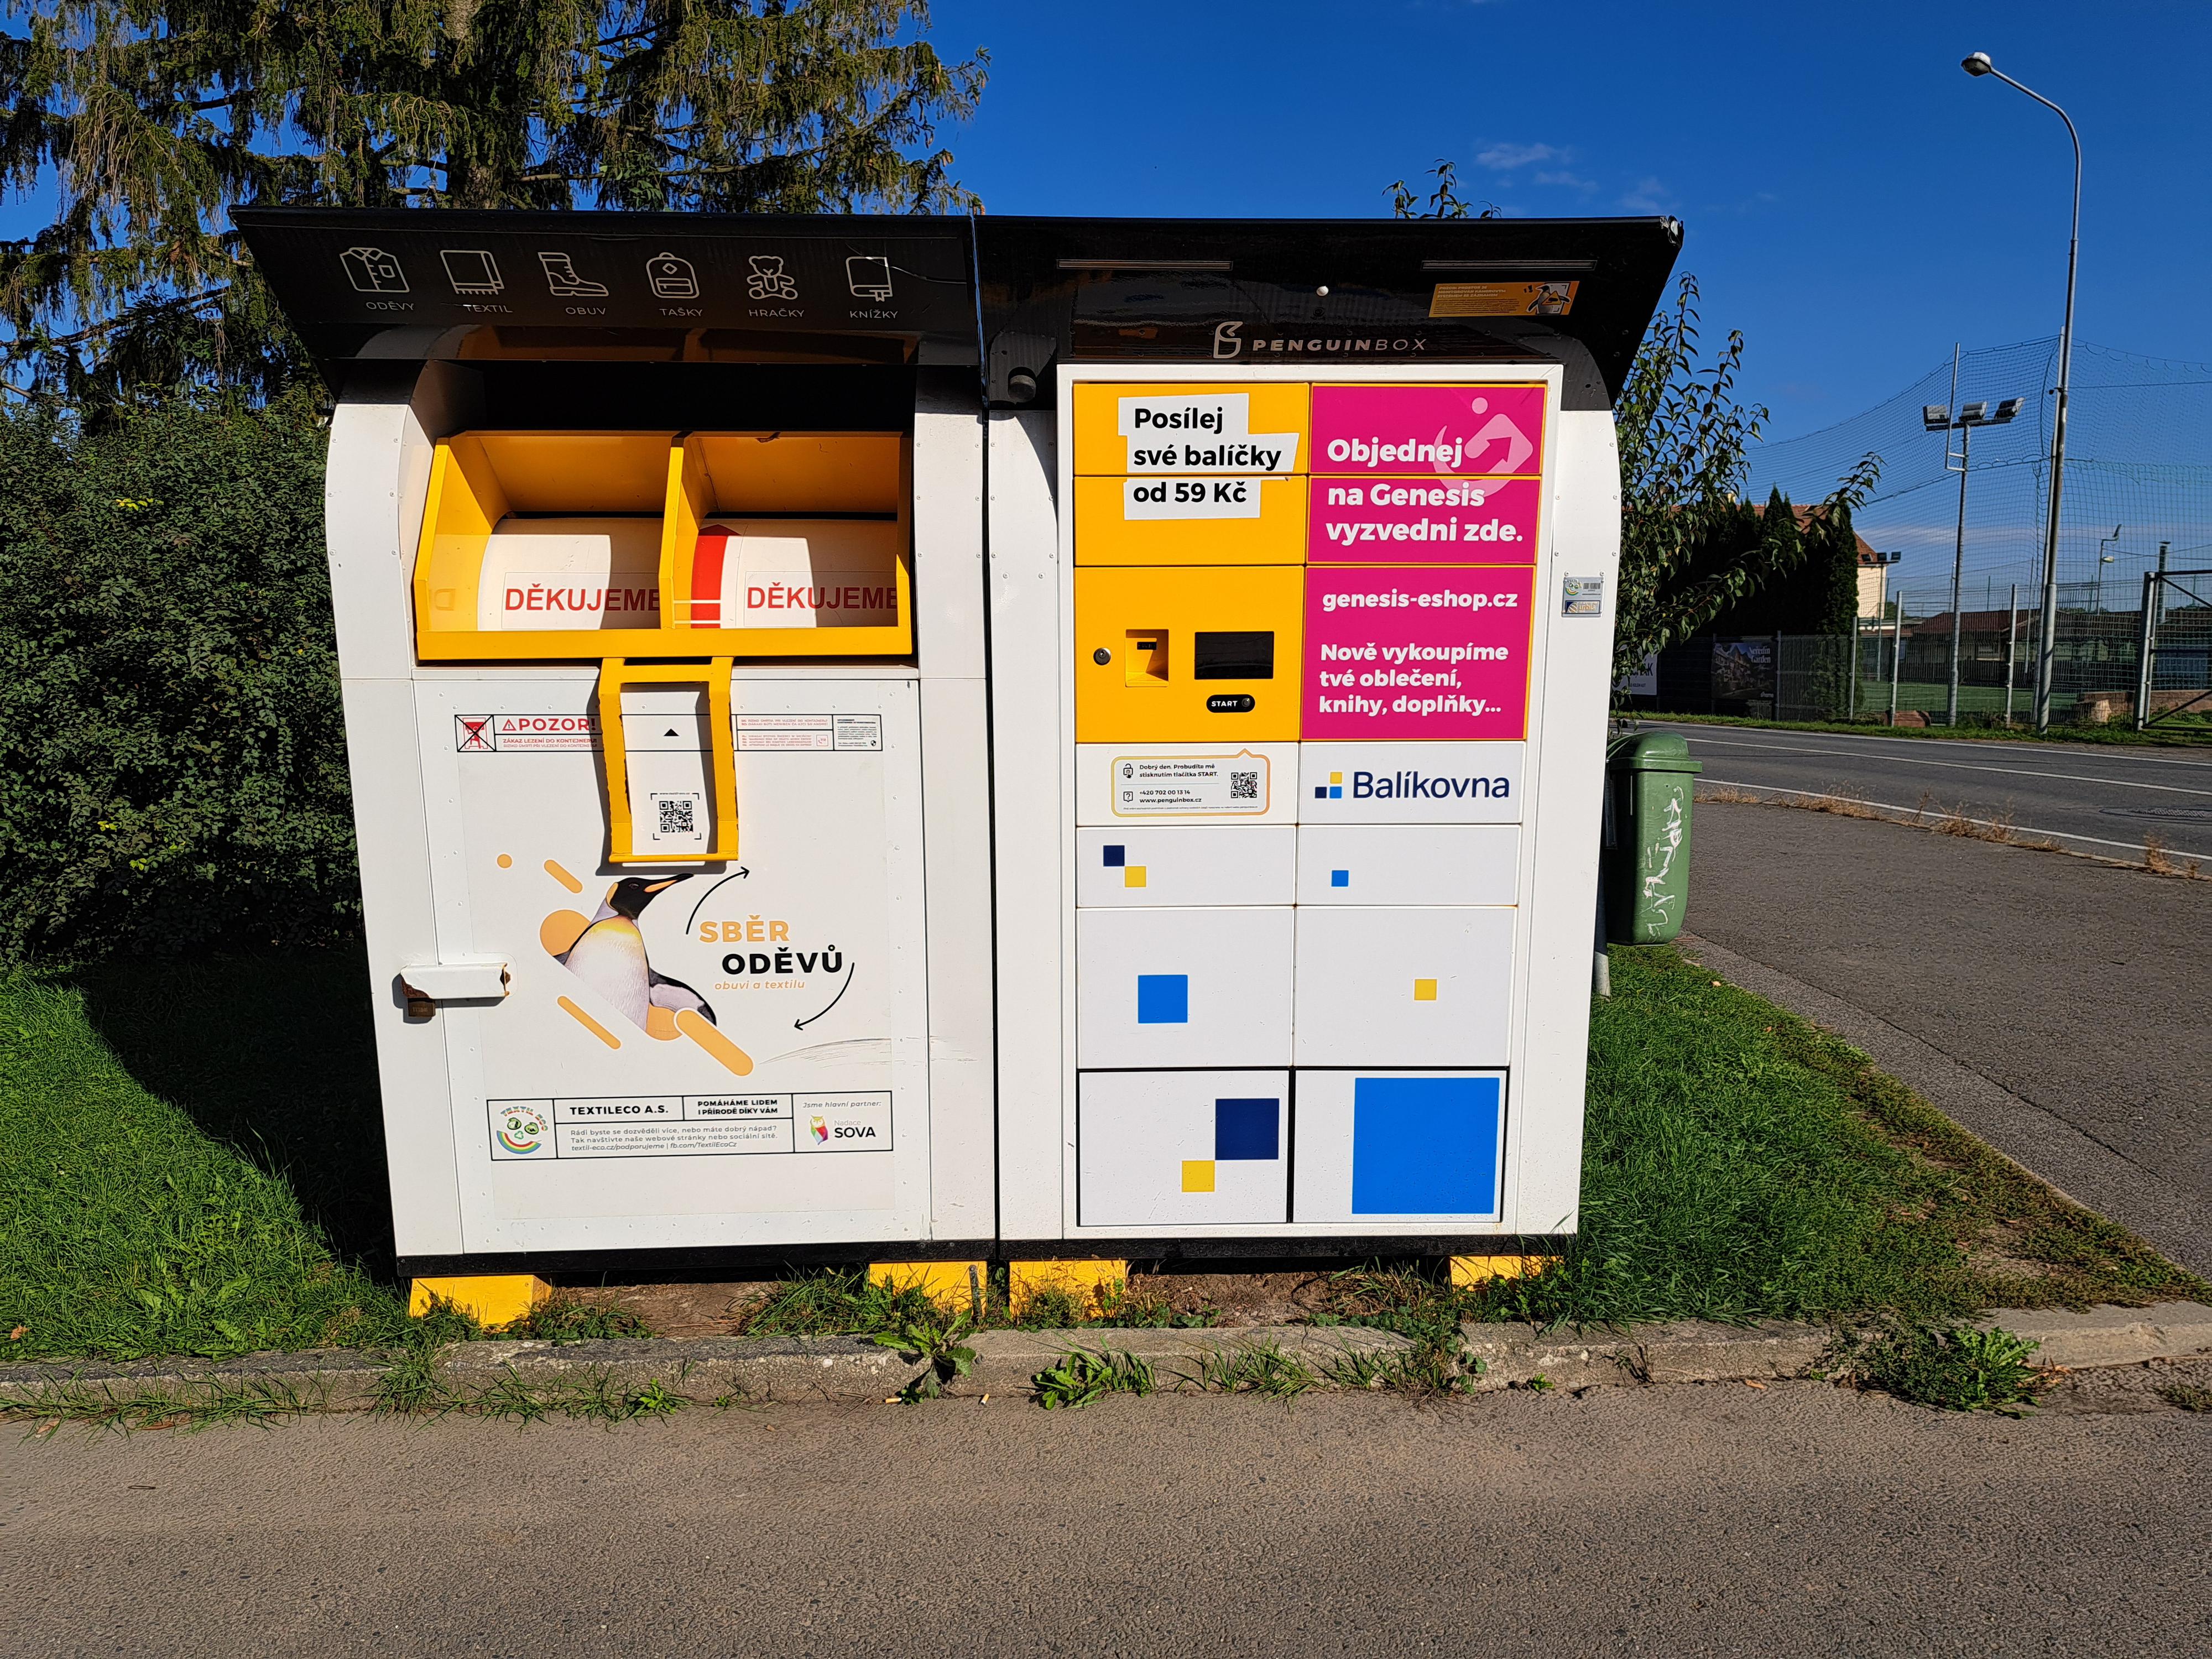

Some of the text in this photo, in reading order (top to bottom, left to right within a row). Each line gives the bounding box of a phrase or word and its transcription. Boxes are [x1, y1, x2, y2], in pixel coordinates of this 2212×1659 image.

[366, 300, 414, 311] ODĚVY
[464, 304, 513, 313] TEXTIL
[565, 306, 606, 315] OBUV
[659, 307, 703, 317] TAŠKY
[749, 307, 805, 318] HRAČKY
[849, 309, 898, 319] KNÍŽKY
[1253, 338, 1427, 352] PENGUINBOX
[1135, 406, 1223, 435] Posílej
[1134, 444, 1282, 471] své balíčky
[1327, 436, 1463, 468] Objednej
[1133, 481, 1248, 503] od 59 Kč
[1328, 482, 1485, 506] na Genesis
[1326, 516, 1523, 546] vyzvedni zde.
[505, 582, 659, 612] DĚKUJEME
[748, 581, 898, 609] DĚKUJEME
[1322, 588, 1518, 612] genesis-eshop.cz
[1321, 642, 1509, 664] Nově vykoupíme
[1319, 669, 1462, 690] tvé oblečení,
[1319, 694, 1501, 717] knihy, doplňky...
[519, 718, 596, 731] POZOR!
[1353, 771, 1510, 799] Balíkovna
[699, 914, 790, 943] SBĚR
[722, 944, 842, 975] ODĚVŮ
[714, 980, 749, 990] obuvi
[765, 979, 805, 989] textilu
[570, 1105, 669, 1115] TEXTILECO A.S.
[702, 1107, 738, 1115] PŘÍRODĚ
[748, 1125, 778, 1133] nápad?
[834, 1126, 877, 1138] SOVA
[571, 1141, 737, 1152] textil-eco.cz/podporujeme fb.com/TextilEcoCz
[677, 1134, 707, 1142] stránky
